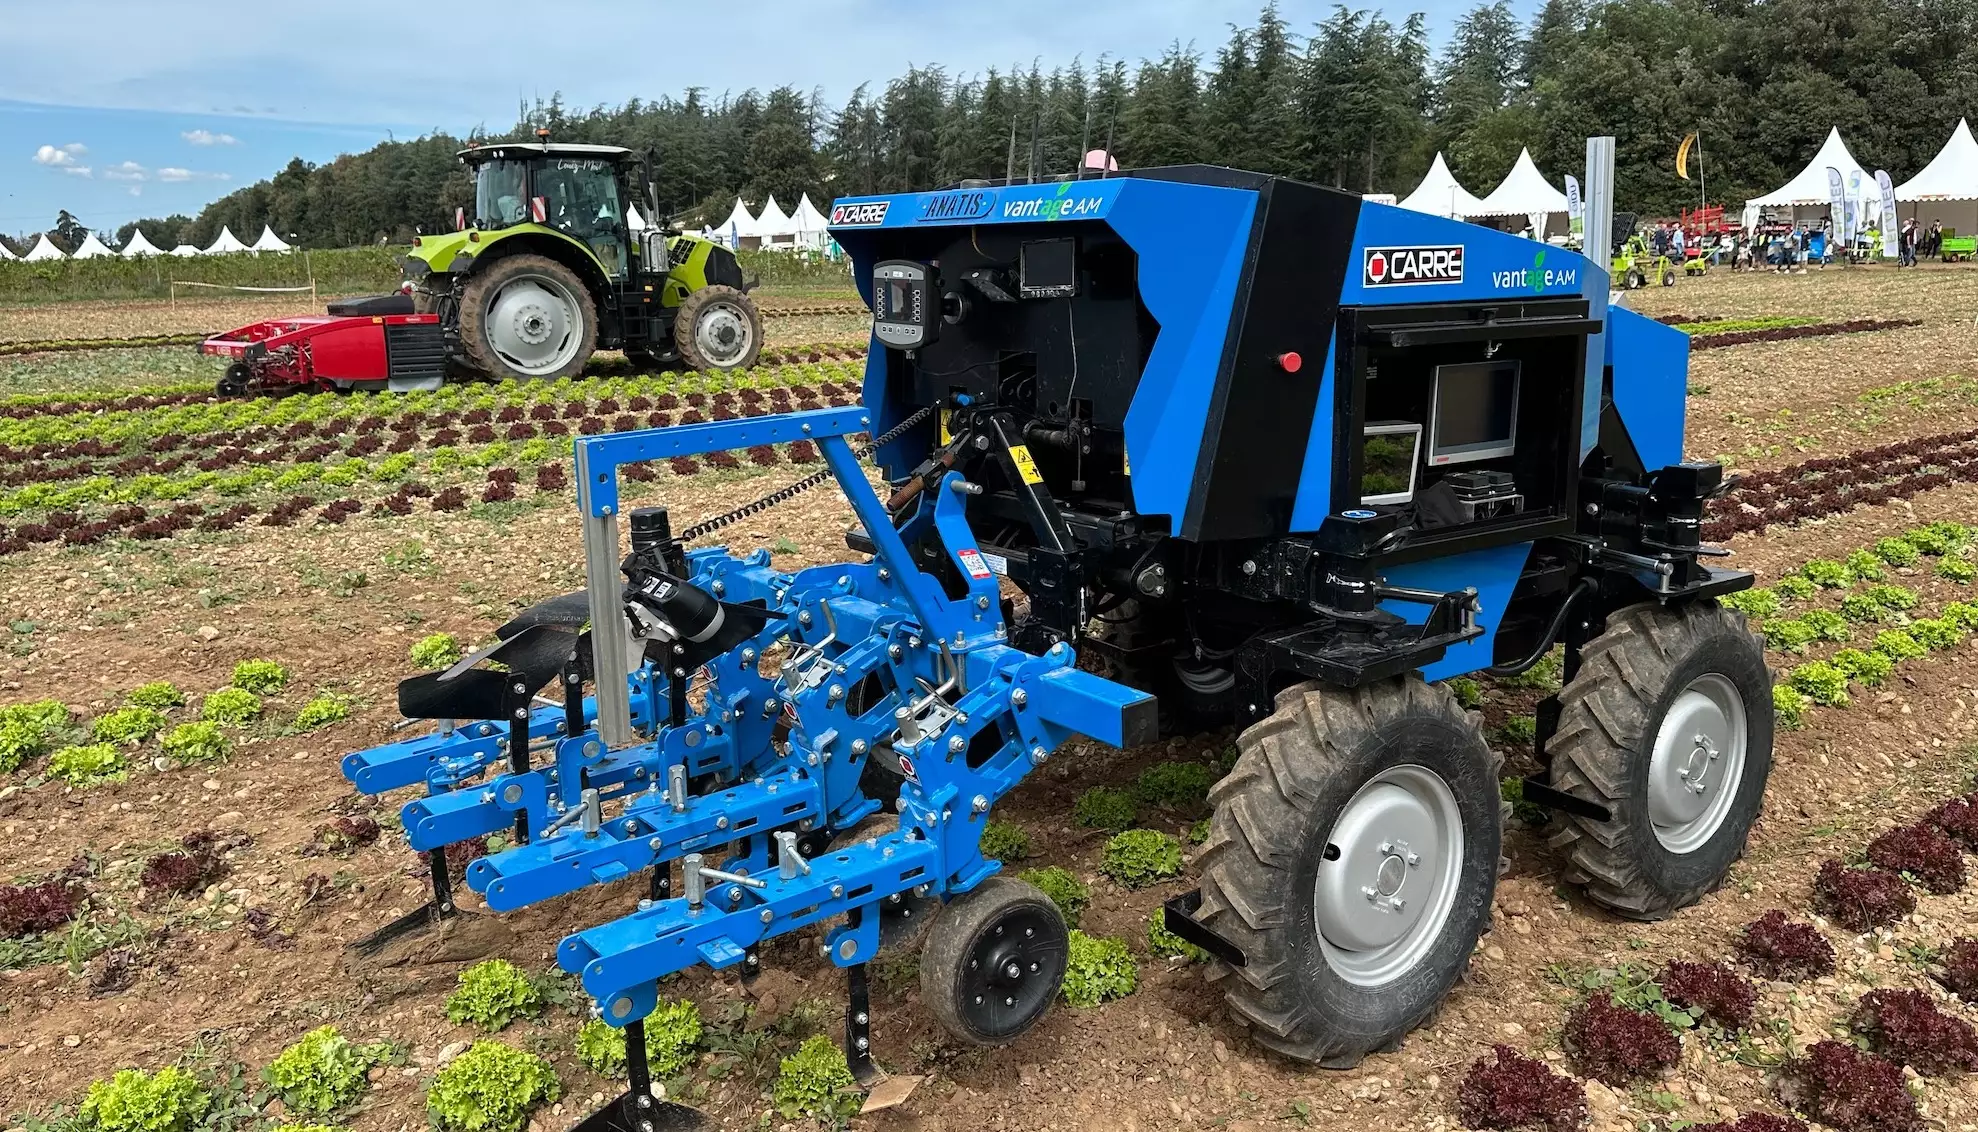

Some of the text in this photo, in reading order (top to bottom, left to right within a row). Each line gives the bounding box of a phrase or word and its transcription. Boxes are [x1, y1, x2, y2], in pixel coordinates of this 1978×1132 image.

[925, 193, 984, 218] ANATIS
[1003, 197, 1103, 221] vantage AM
[1492, 268, 1576, 292] vantage AM
